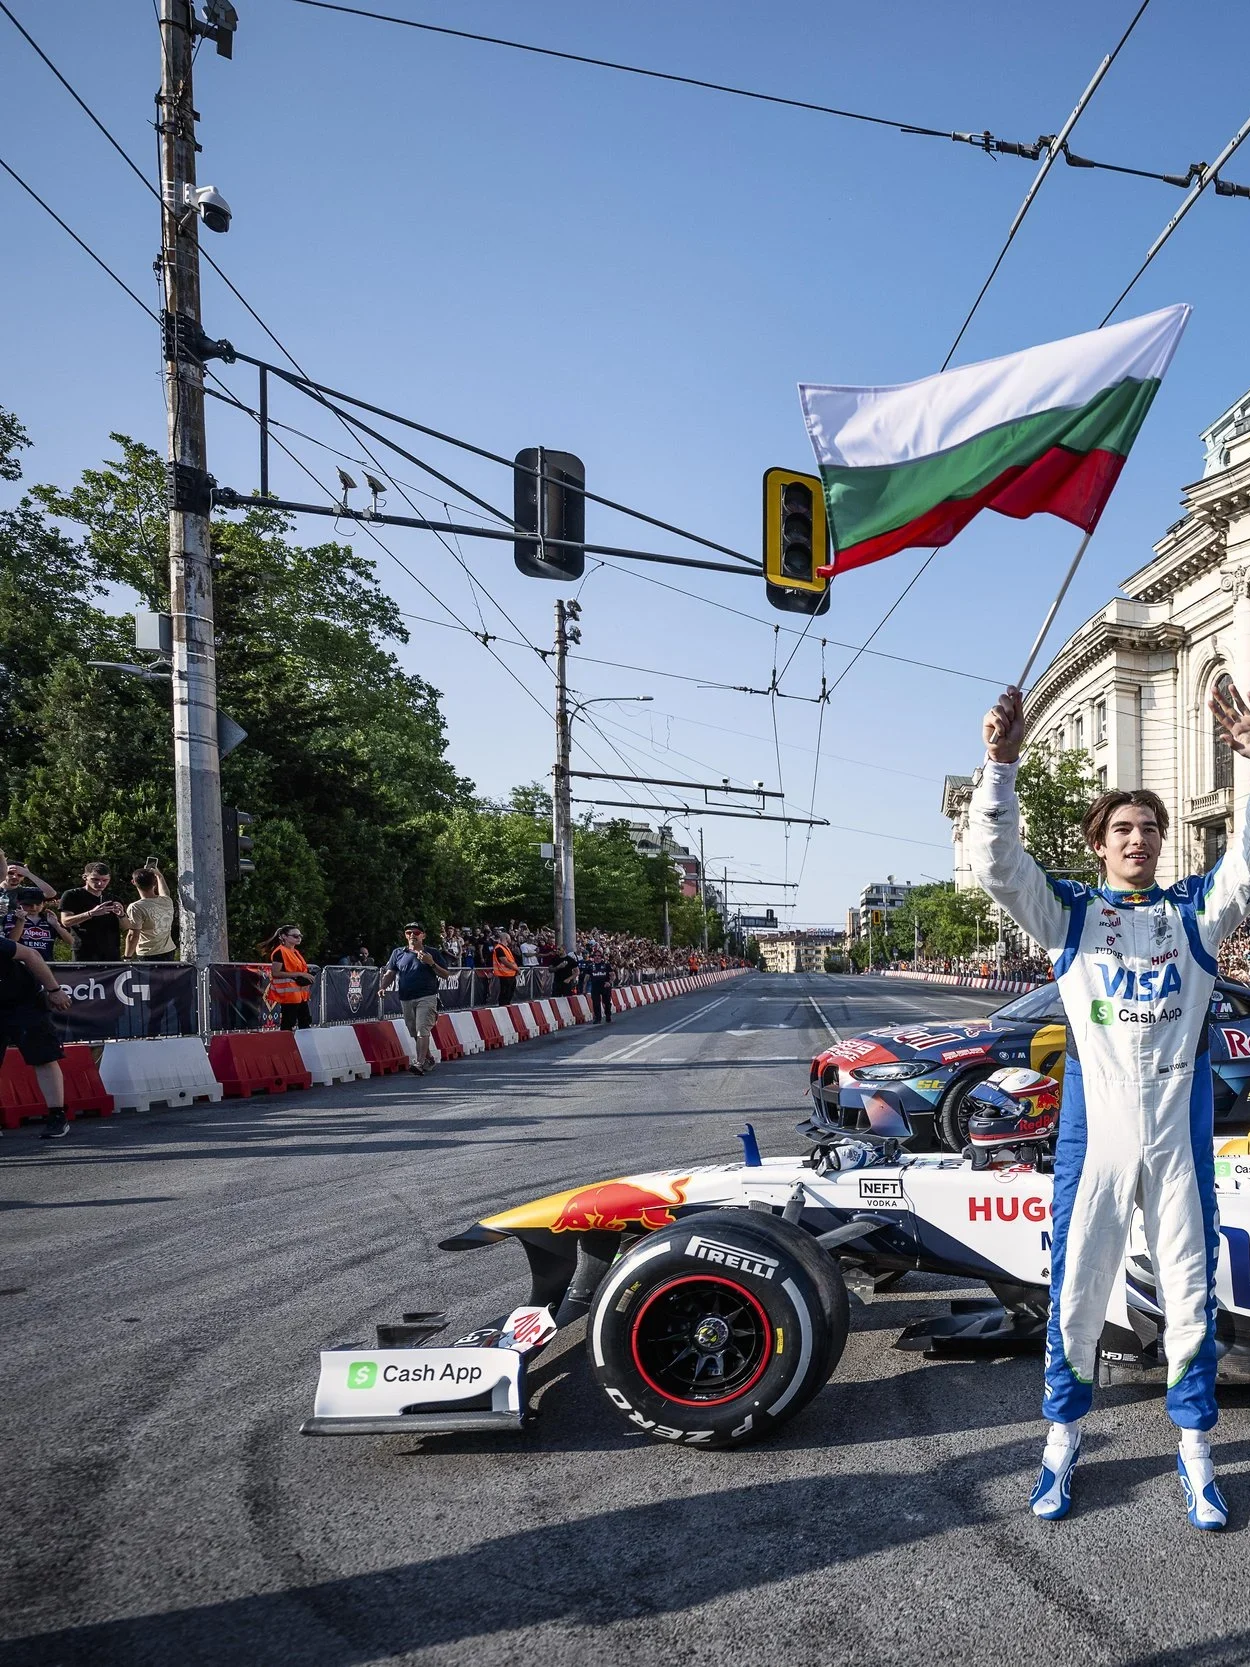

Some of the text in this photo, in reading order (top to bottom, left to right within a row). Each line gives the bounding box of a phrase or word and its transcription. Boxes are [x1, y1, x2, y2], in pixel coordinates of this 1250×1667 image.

[23, 929, 50, 938] Alpecin
[1095, 946, 1123, 960] TUDOR
[1151, 948, 1179, 966] HUGO
[1094, 963, 1182, 1001] VISA
[1118, 1007, 1182, 1023] Cash App
[863, 1183, 898, 1195] NEFT
[866, 1199, 898, 1207] VODKA
[968, 1196, 1052, 1222] HUG
[684, 1235, 780, 1280] PIRELLI
[383, 1363, 482, 1384] Cash App
[604, 1386, 716, 1443] ZERO
